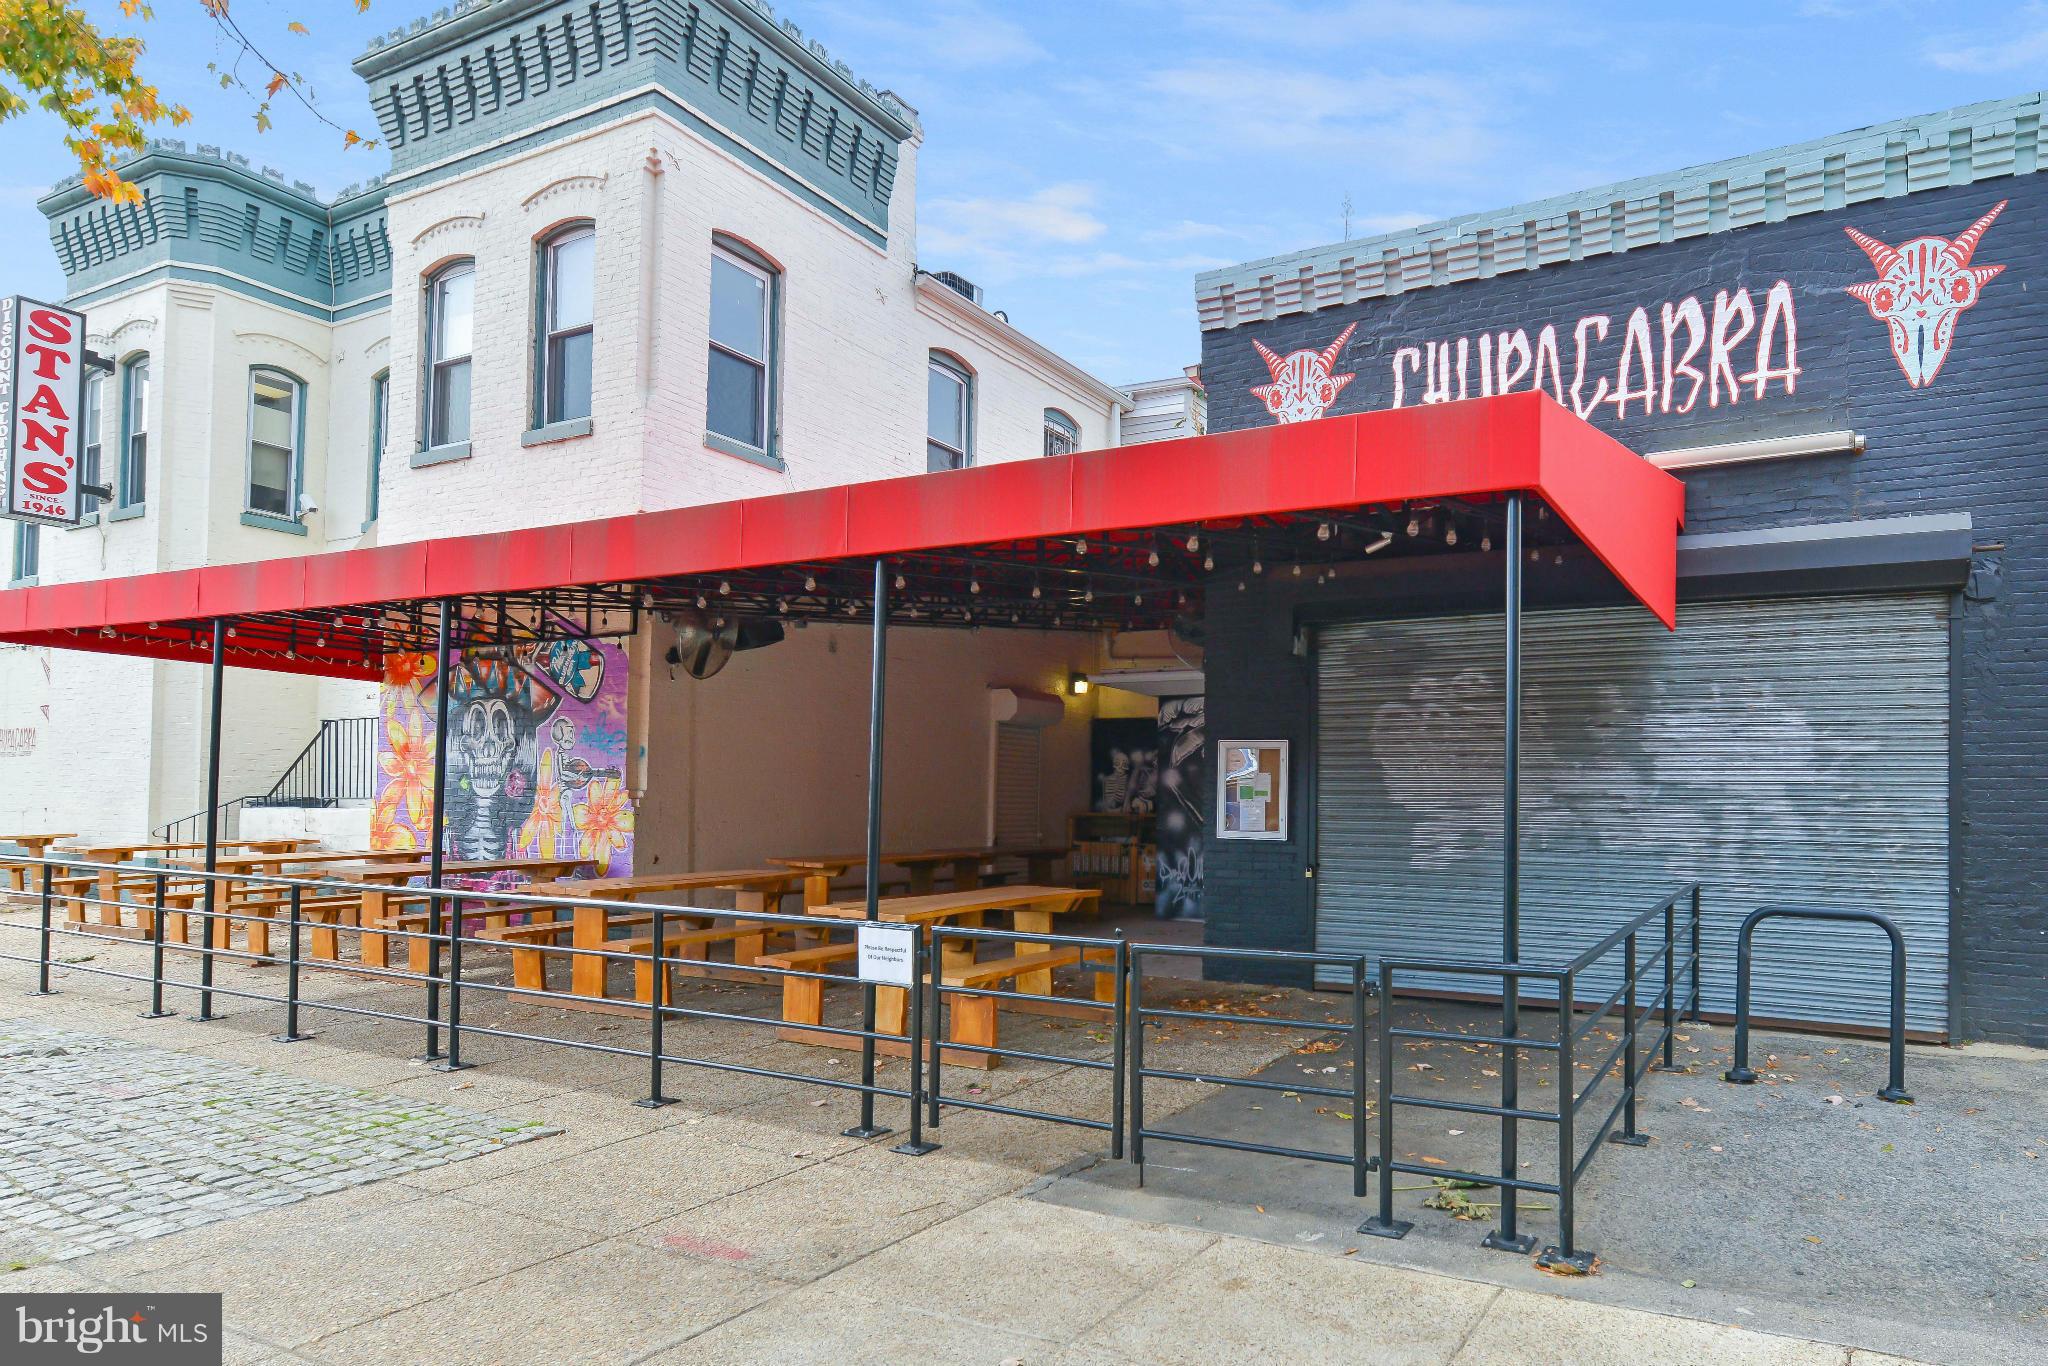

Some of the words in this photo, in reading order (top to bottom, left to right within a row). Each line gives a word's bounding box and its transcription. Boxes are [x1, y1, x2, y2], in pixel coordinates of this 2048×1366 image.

[0, 297, 13, 395] DISCOUNT
[1391, 279, 1802, 421] CHUPACABRA
[21, 309, 75, 495] STAN'S
[21, 500, 67, 516] 1946
[29, 492, 59, 504] SINCE
